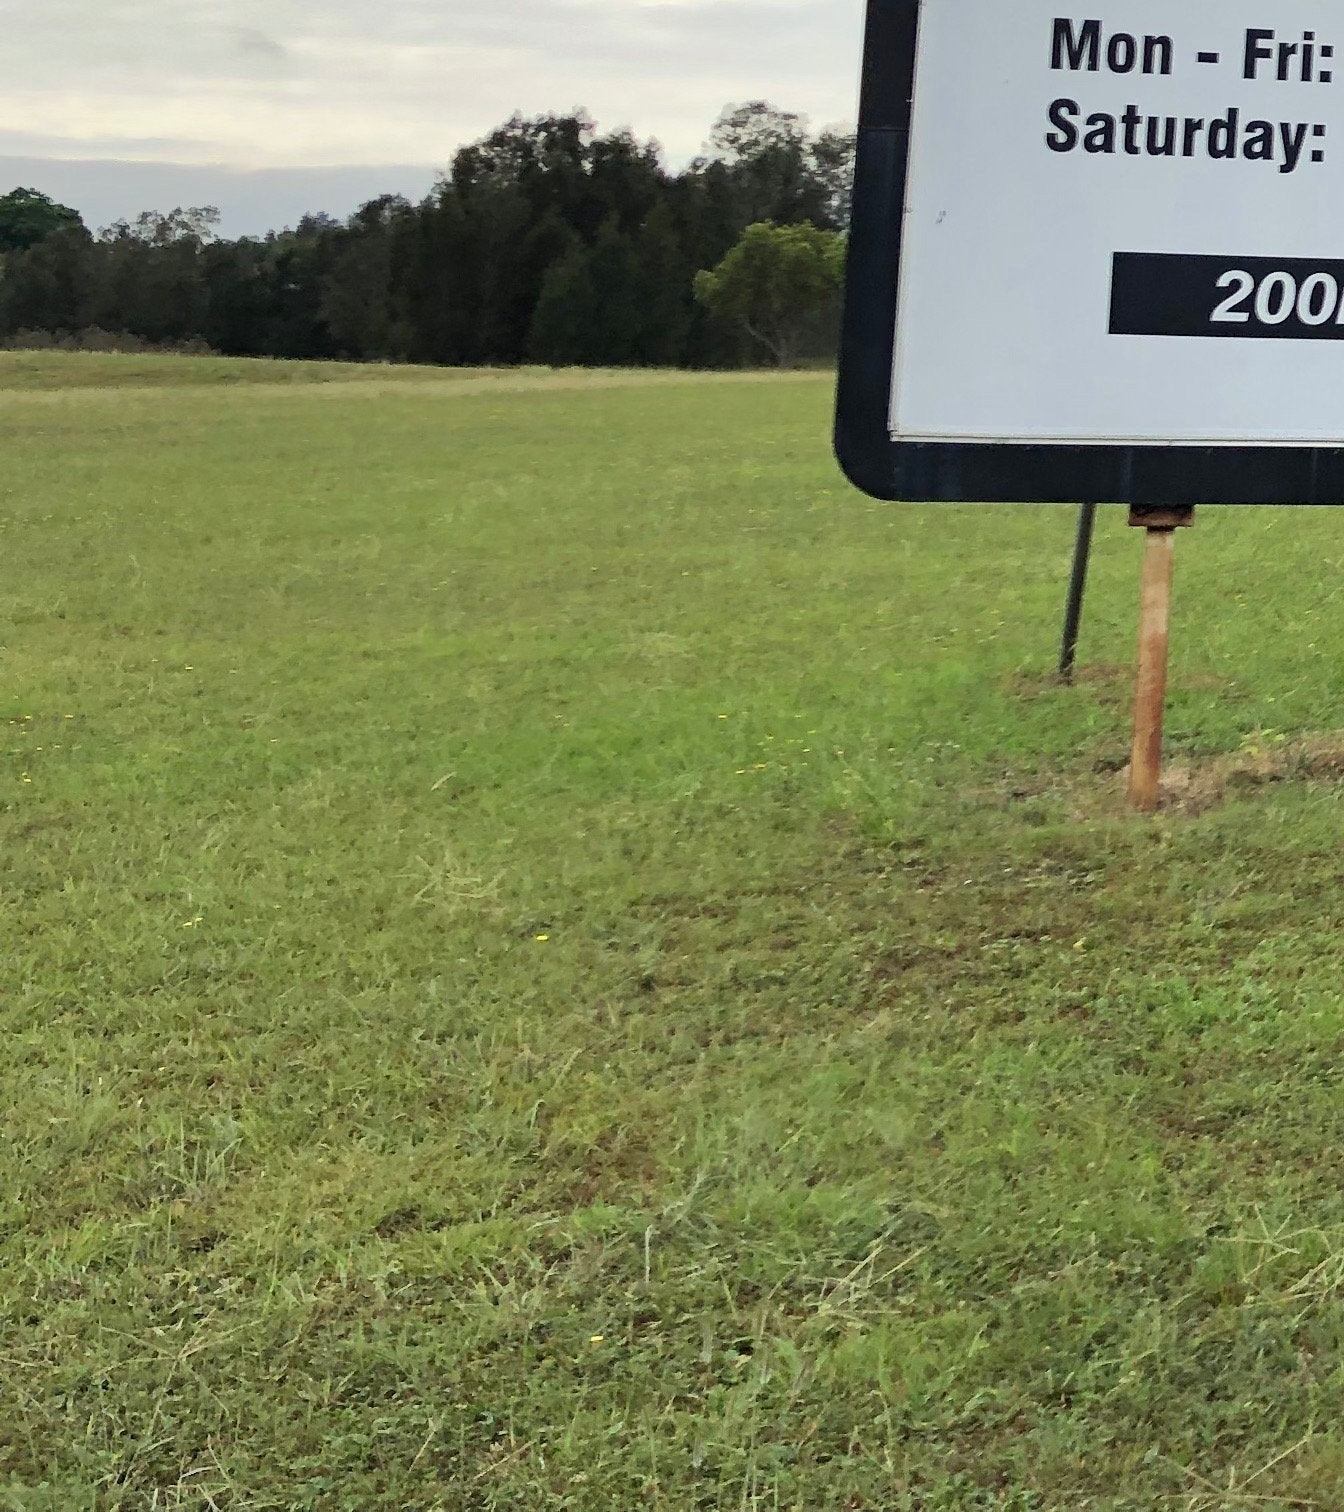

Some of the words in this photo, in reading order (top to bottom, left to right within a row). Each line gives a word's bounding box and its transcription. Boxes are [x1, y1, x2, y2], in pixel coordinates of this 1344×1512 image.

[1050, 17, 1173, 75] Mon
[1197, 51, 1220, 64] -
[1243, 28, 1334, 83] Fri:
[1046, 98, 1326, 174] Saturday:
